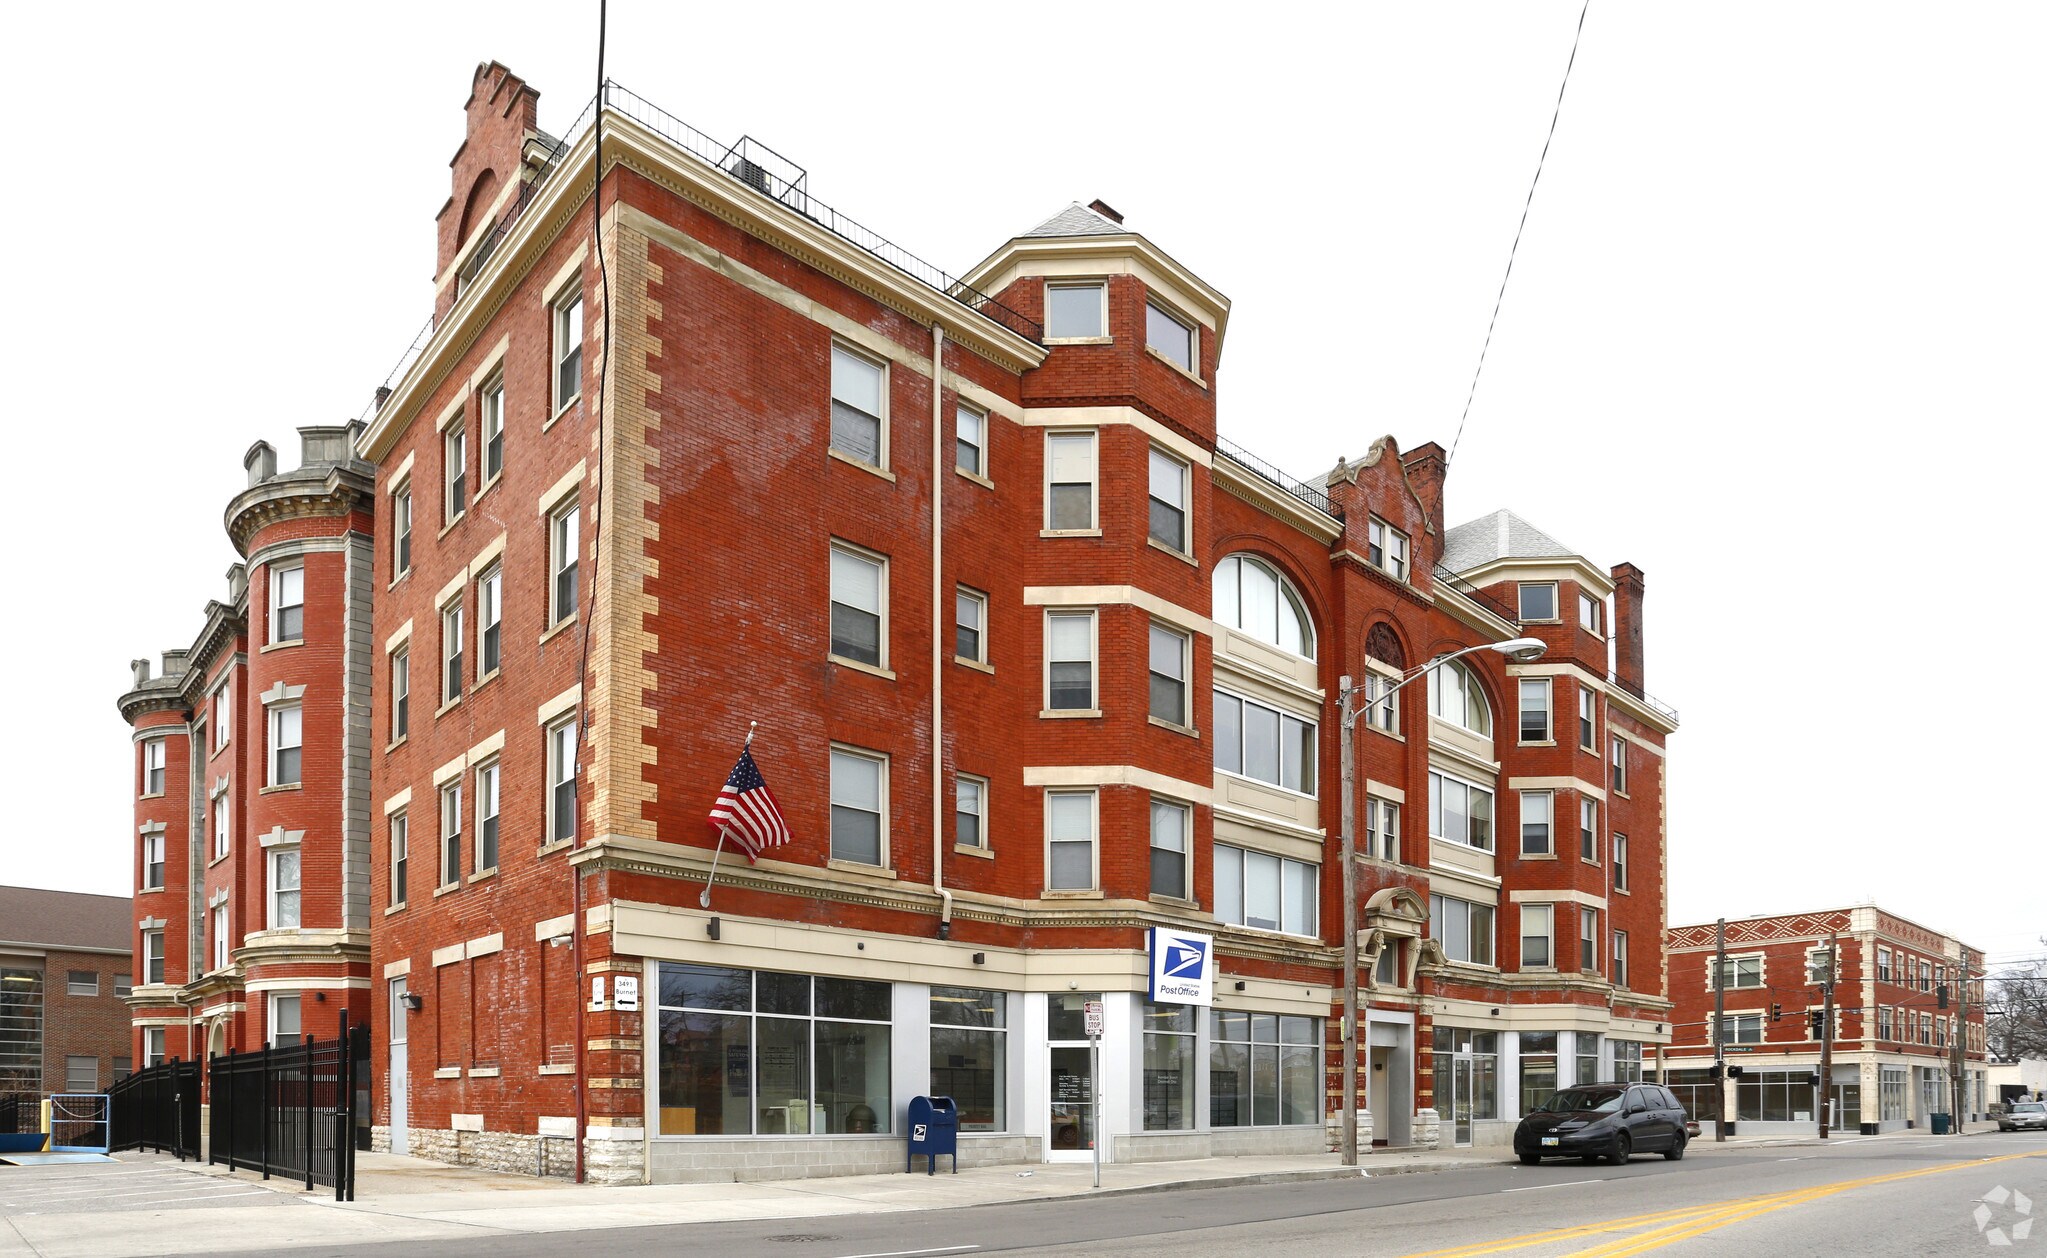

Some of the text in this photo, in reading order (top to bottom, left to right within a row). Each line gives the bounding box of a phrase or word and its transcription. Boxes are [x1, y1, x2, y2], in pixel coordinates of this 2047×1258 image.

[615, 988, 636, 996] Burnet
[1160, 984, 1199, 997] Post Office
[1087, 1021, 1101, 1029] STOP
